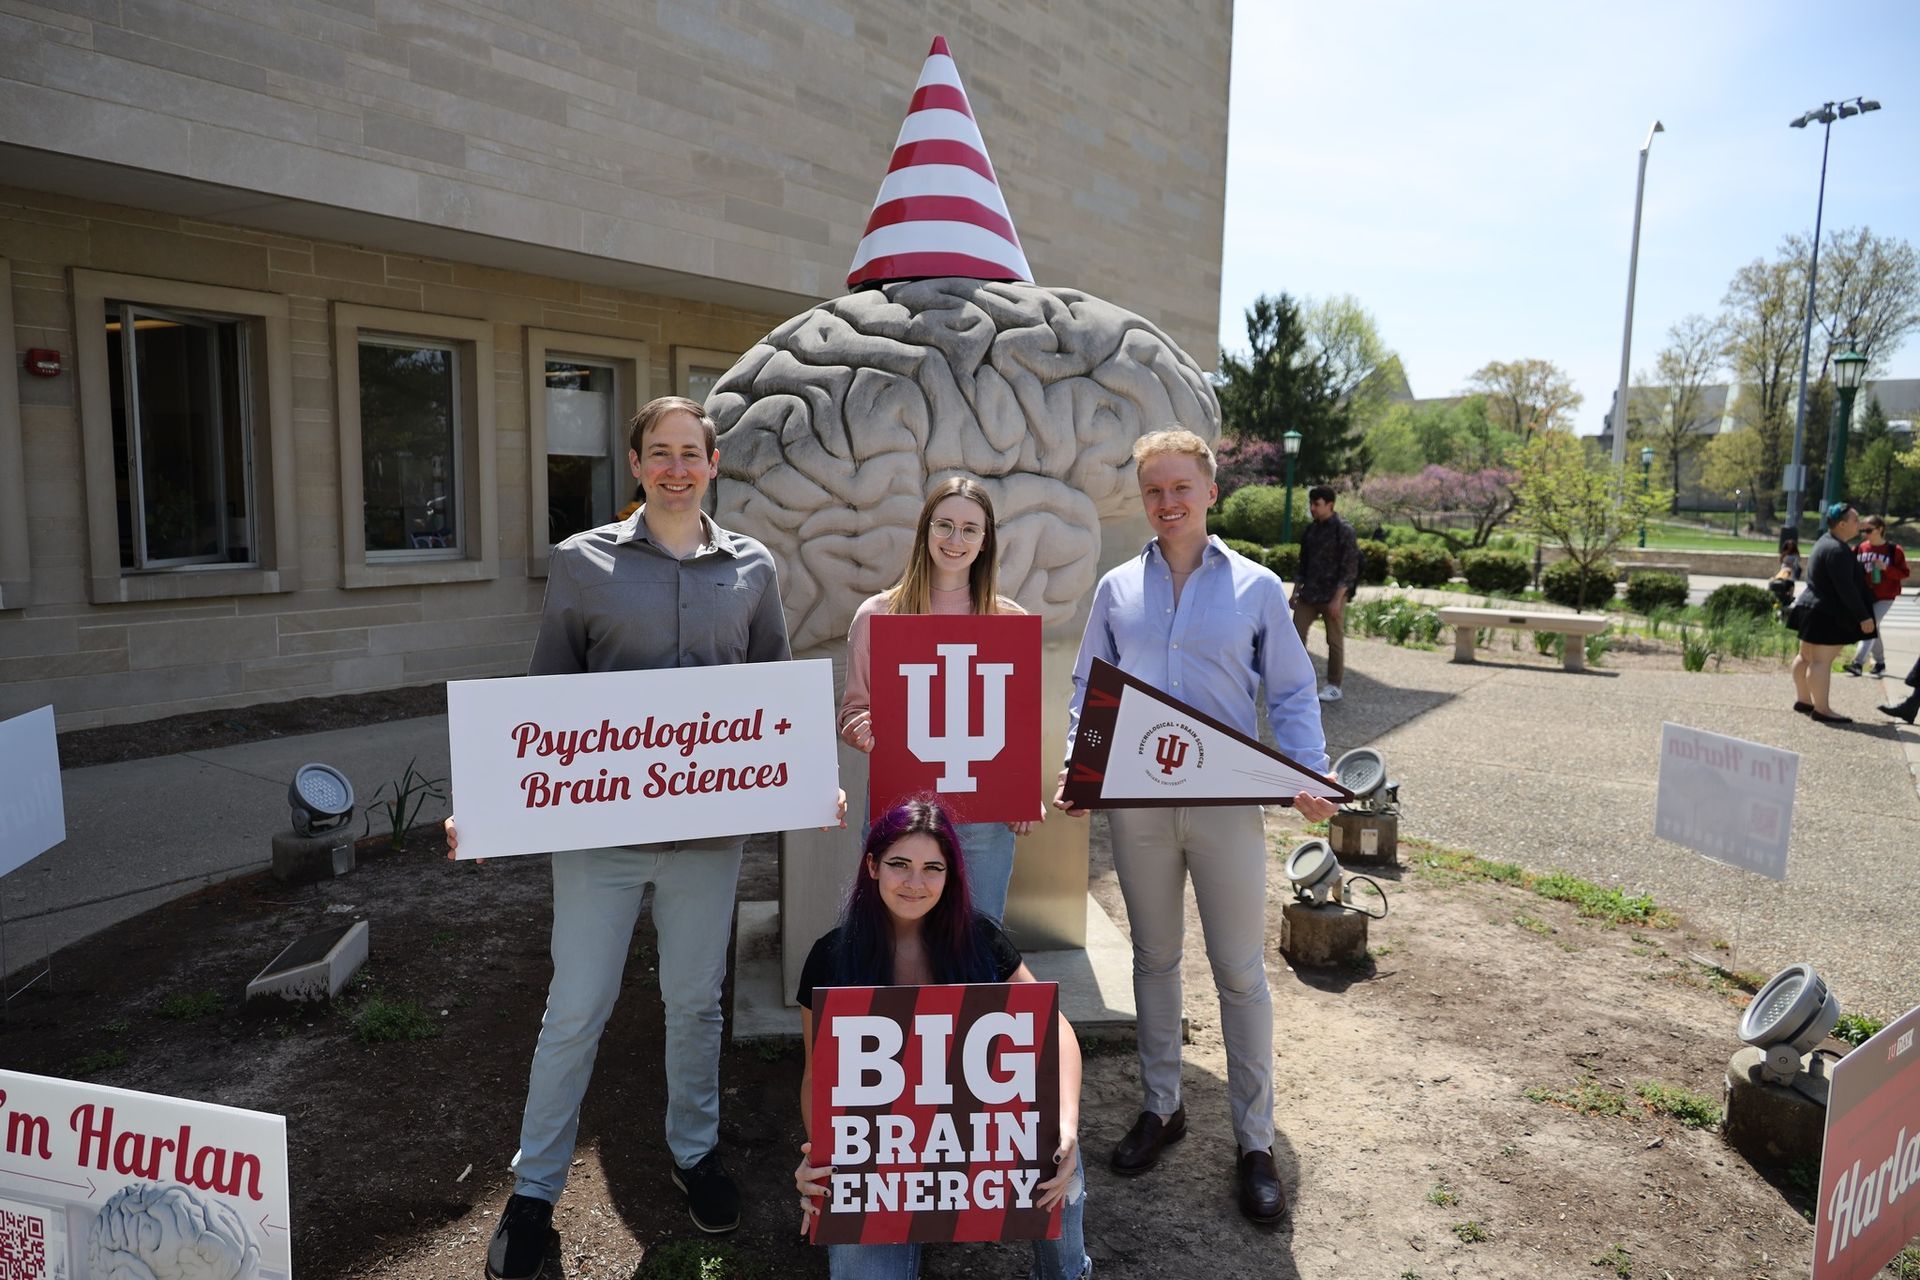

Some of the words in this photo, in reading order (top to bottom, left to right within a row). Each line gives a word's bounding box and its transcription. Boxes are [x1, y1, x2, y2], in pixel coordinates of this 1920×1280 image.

[511, 708, 763, 766] Psychological
[774, 718, 792, 735] +
[1138, 722, 1175, 755] PSYCHOLOGICAL
[1180, 723, 1198, 740] BRAIN
[1195, 738, 1205, 769] SCIENCES
[520, 768, 631, 809] Brain
[642, 761, 789, 799] Sciences
[831, 1011, 1037, 1107] BIG
[1898, 1030, 1913, 1054] DAY
[0, 1089, 52, 1160] 'm
[69, 1103, 264, 1201] Harlan
[831, 1111, 1040, 1166] BRAIN
[830, 1169, 1041, 1213] ENERGY
[1827, 1126, 1920, 1264] Harla
